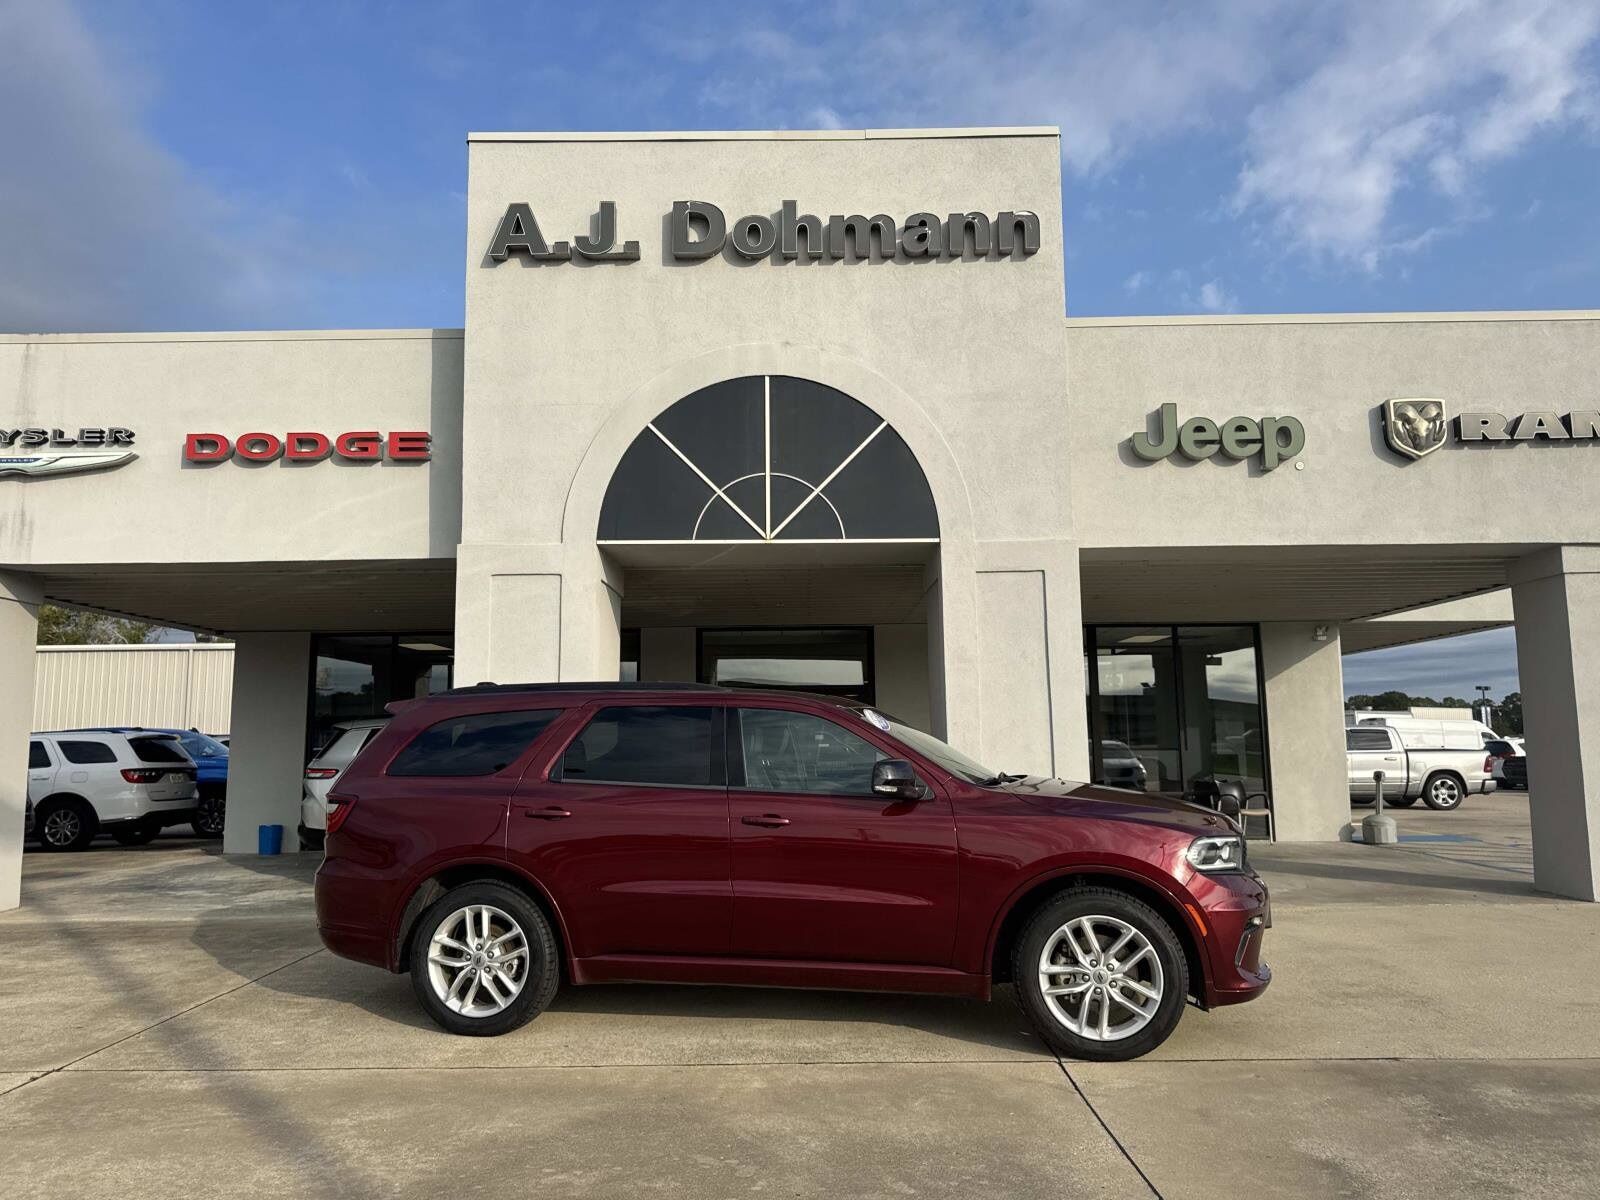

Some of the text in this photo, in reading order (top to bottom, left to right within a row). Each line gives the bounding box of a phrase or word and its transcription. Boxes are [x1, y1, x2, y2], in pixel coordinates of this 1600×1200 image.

[487, 199, 1041, 261] A.J. Dohmann
[184, 431, 432, 462] DODGE
[1130, 402, 1306, 470] Jeep
